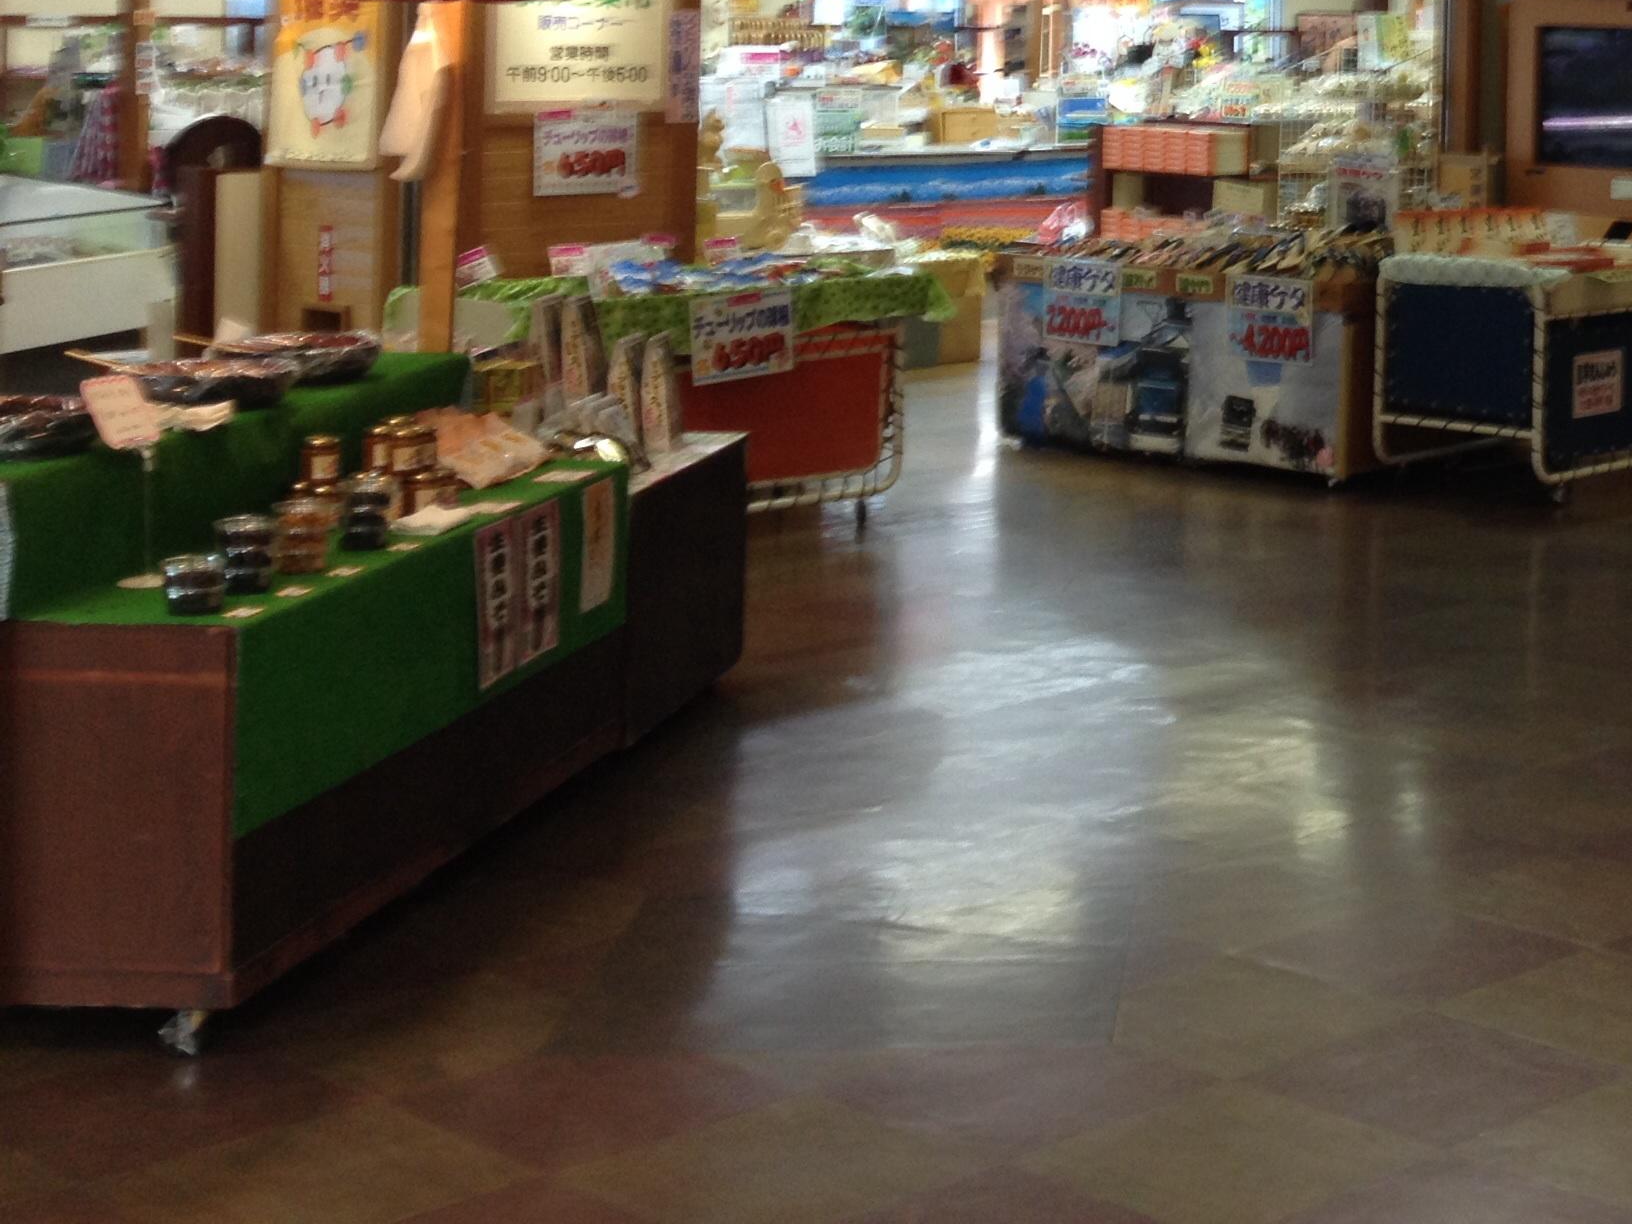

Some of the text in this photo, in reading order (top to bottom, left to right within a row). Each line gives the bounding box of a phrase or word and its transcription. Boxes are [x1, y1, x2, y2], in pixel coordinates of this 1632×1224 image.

[550, 45, 610, 62] 営業時間
[1051, 264, 1118, 294] 健康ゲタ
[1233, 280, 1306, 311] 健康ゲタ
